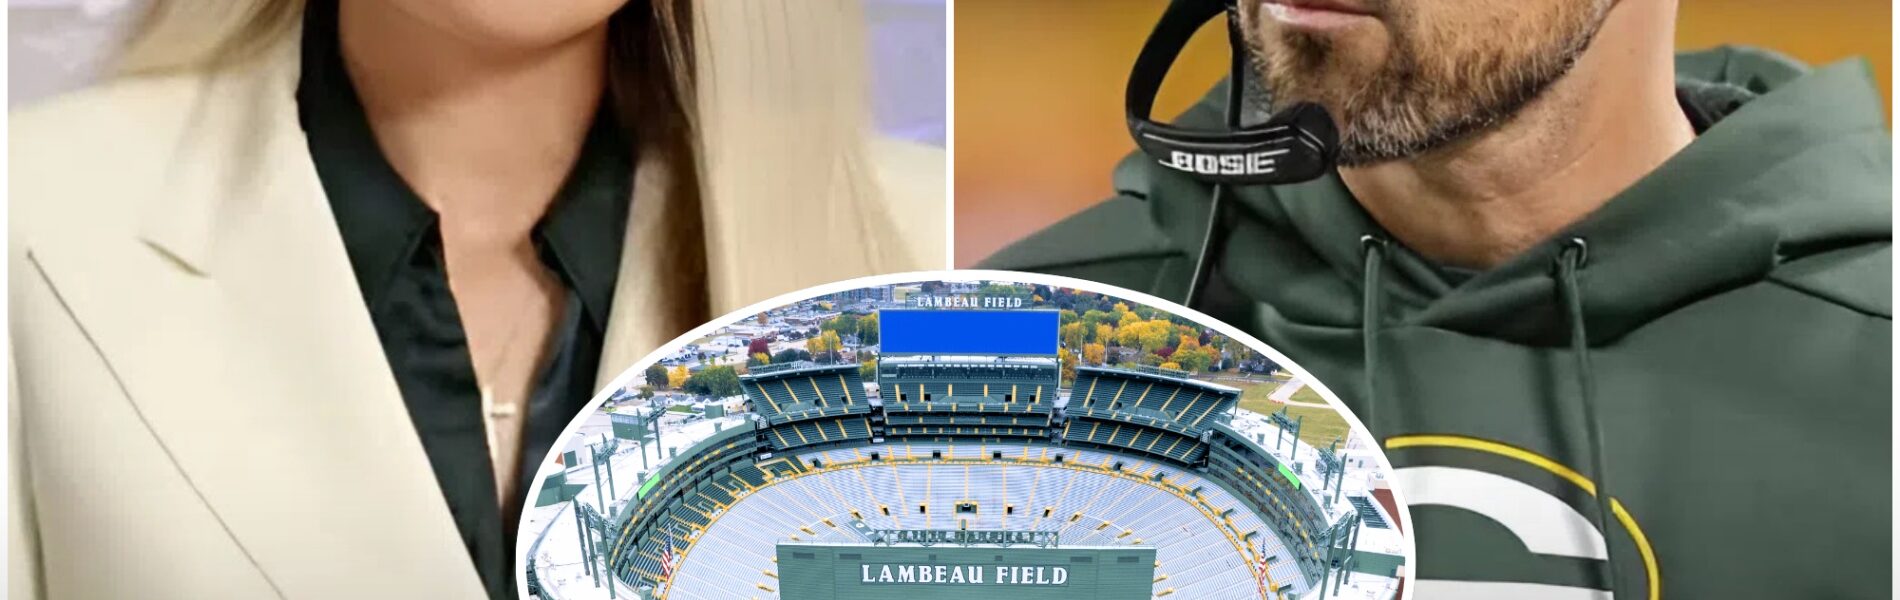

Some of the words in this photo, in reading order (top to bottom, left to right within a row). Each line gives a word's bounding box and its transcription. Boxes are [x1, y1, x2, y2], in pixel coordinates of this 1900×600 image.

[1159, 149, 1289, 174] BOSE
[917, 296, 978, 308] LAMBEAU
[984, 297, 1022, 308] FIELD
[862, 564, 983, 584] LAMBEAU
[996, 566, 1068, 585] FIELD
